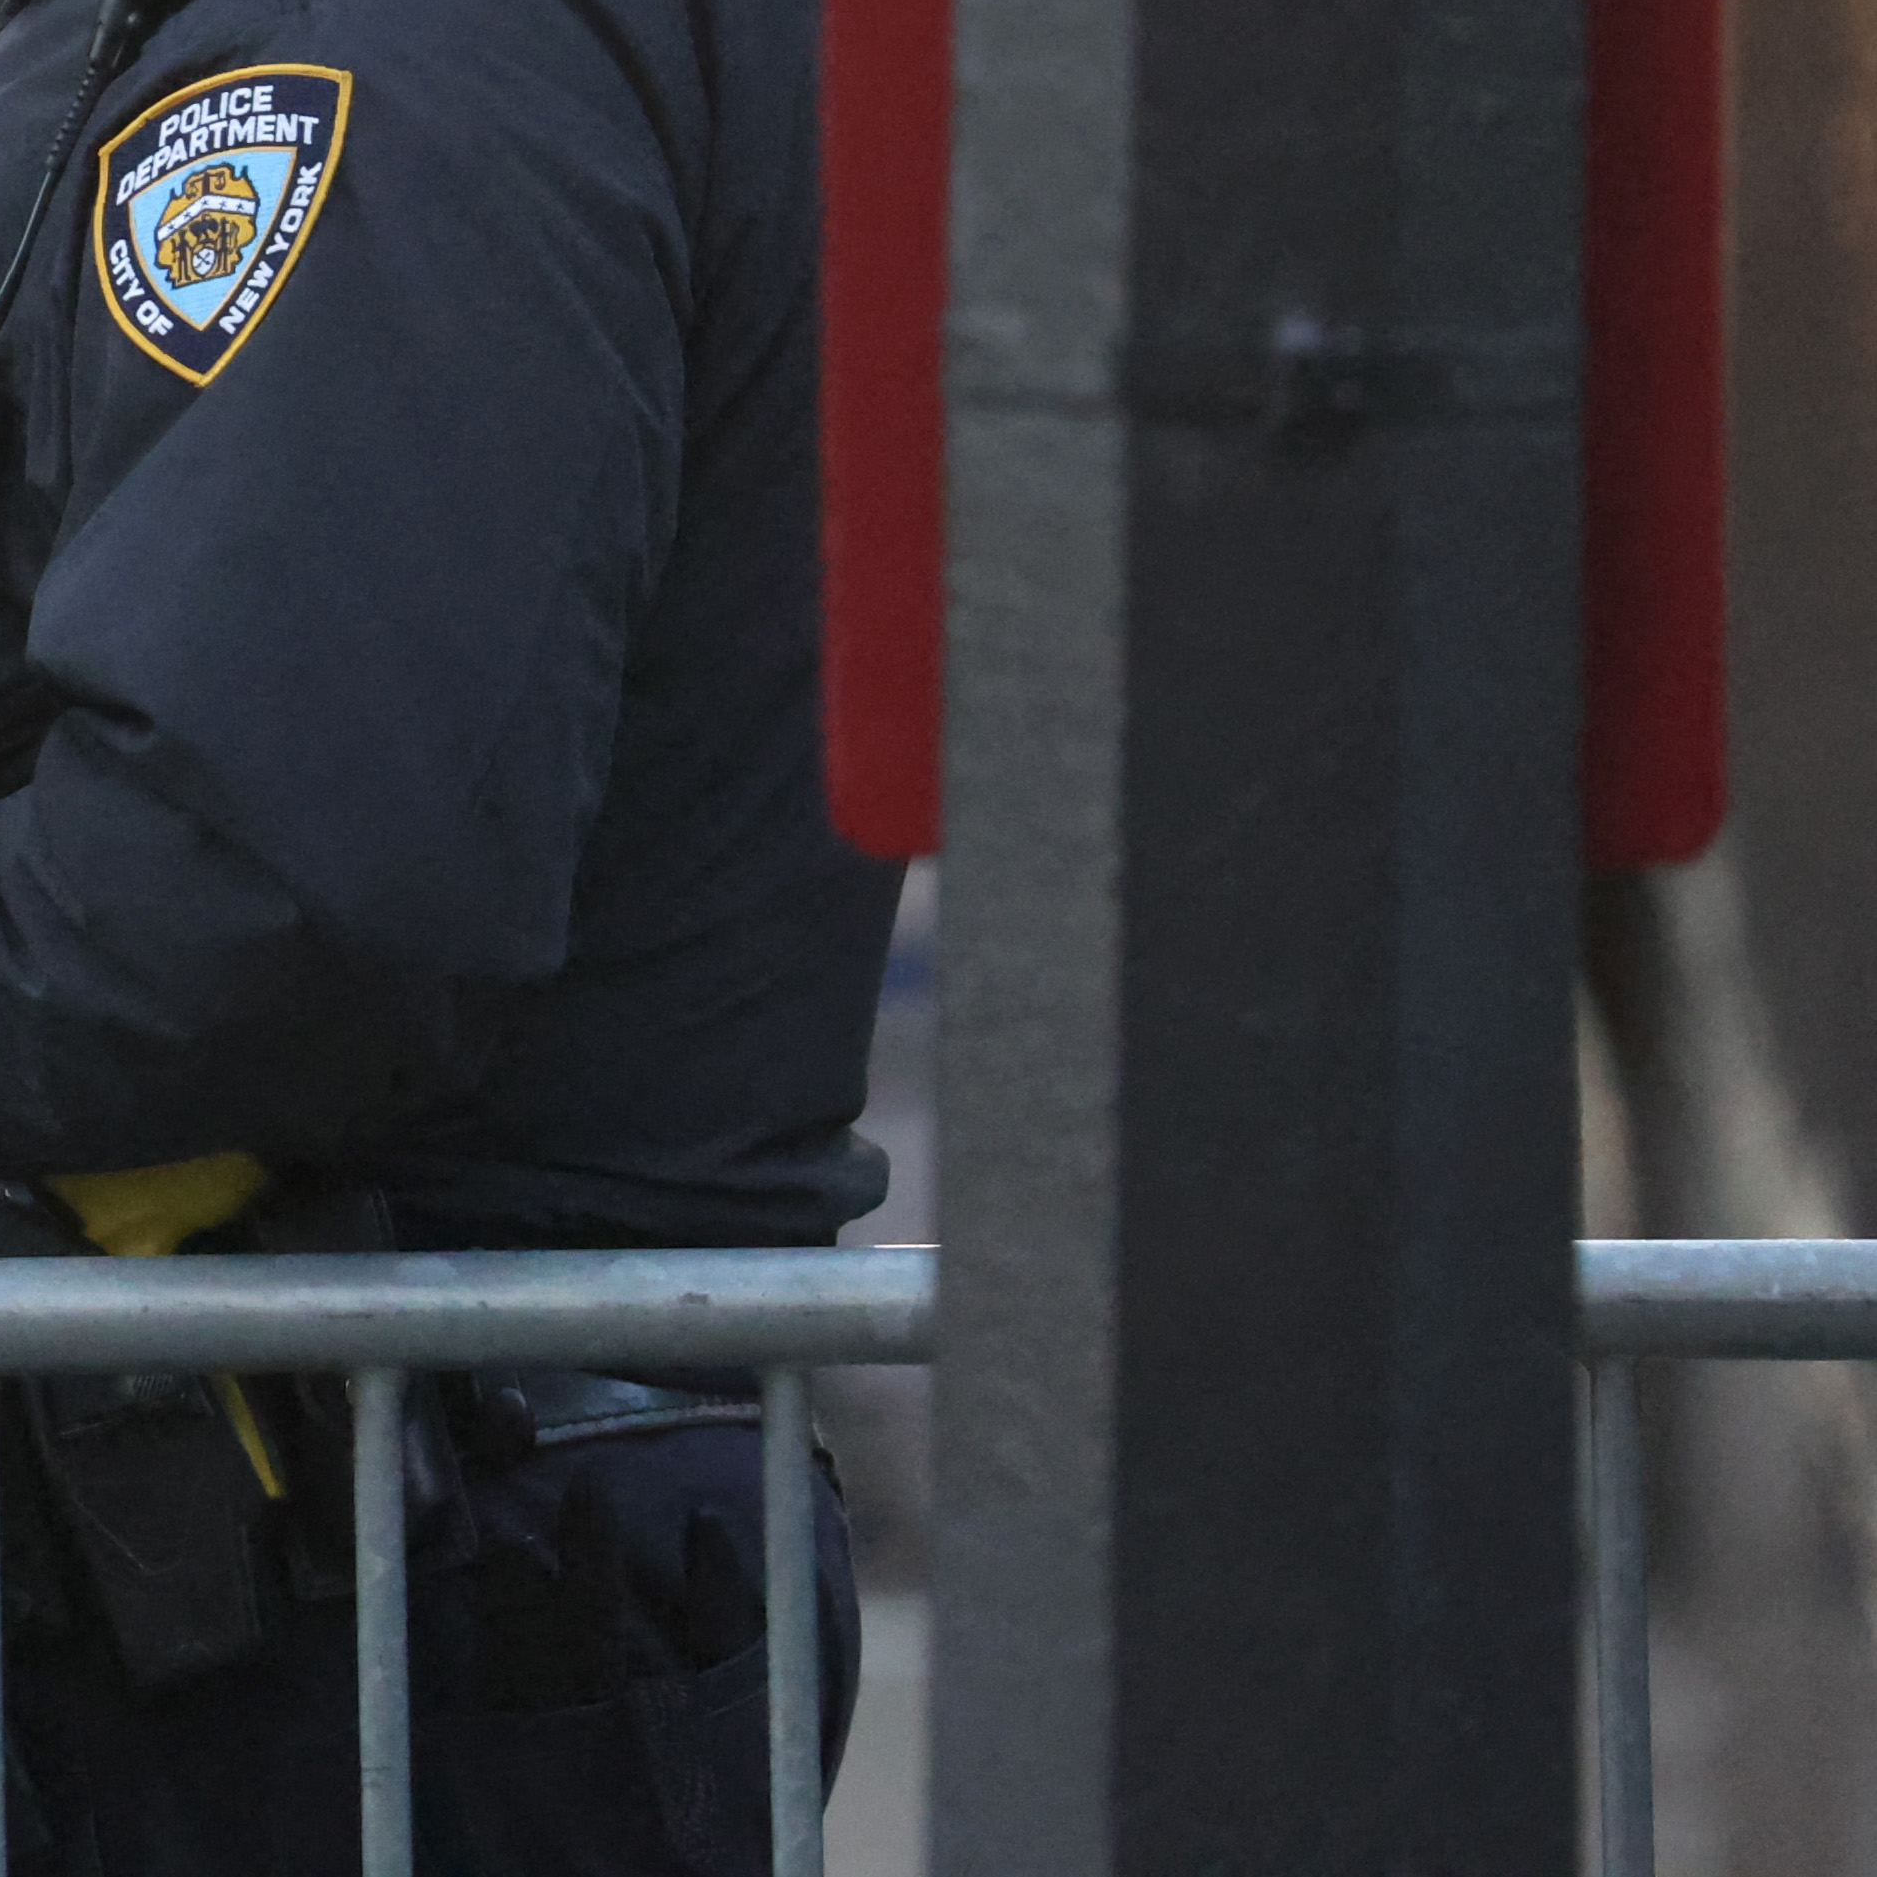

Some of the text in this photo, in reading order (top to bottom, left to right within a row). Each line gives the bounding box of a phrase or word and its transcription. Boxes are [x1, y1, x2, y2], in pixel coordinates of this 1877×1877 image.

[115, 114, 320, 206] DEPARTMENT
[158, 85, 274, 147] POLICE
[109, 239, 174, 337] CITY OF
[218, 161, 323, 334] NEW YORK
